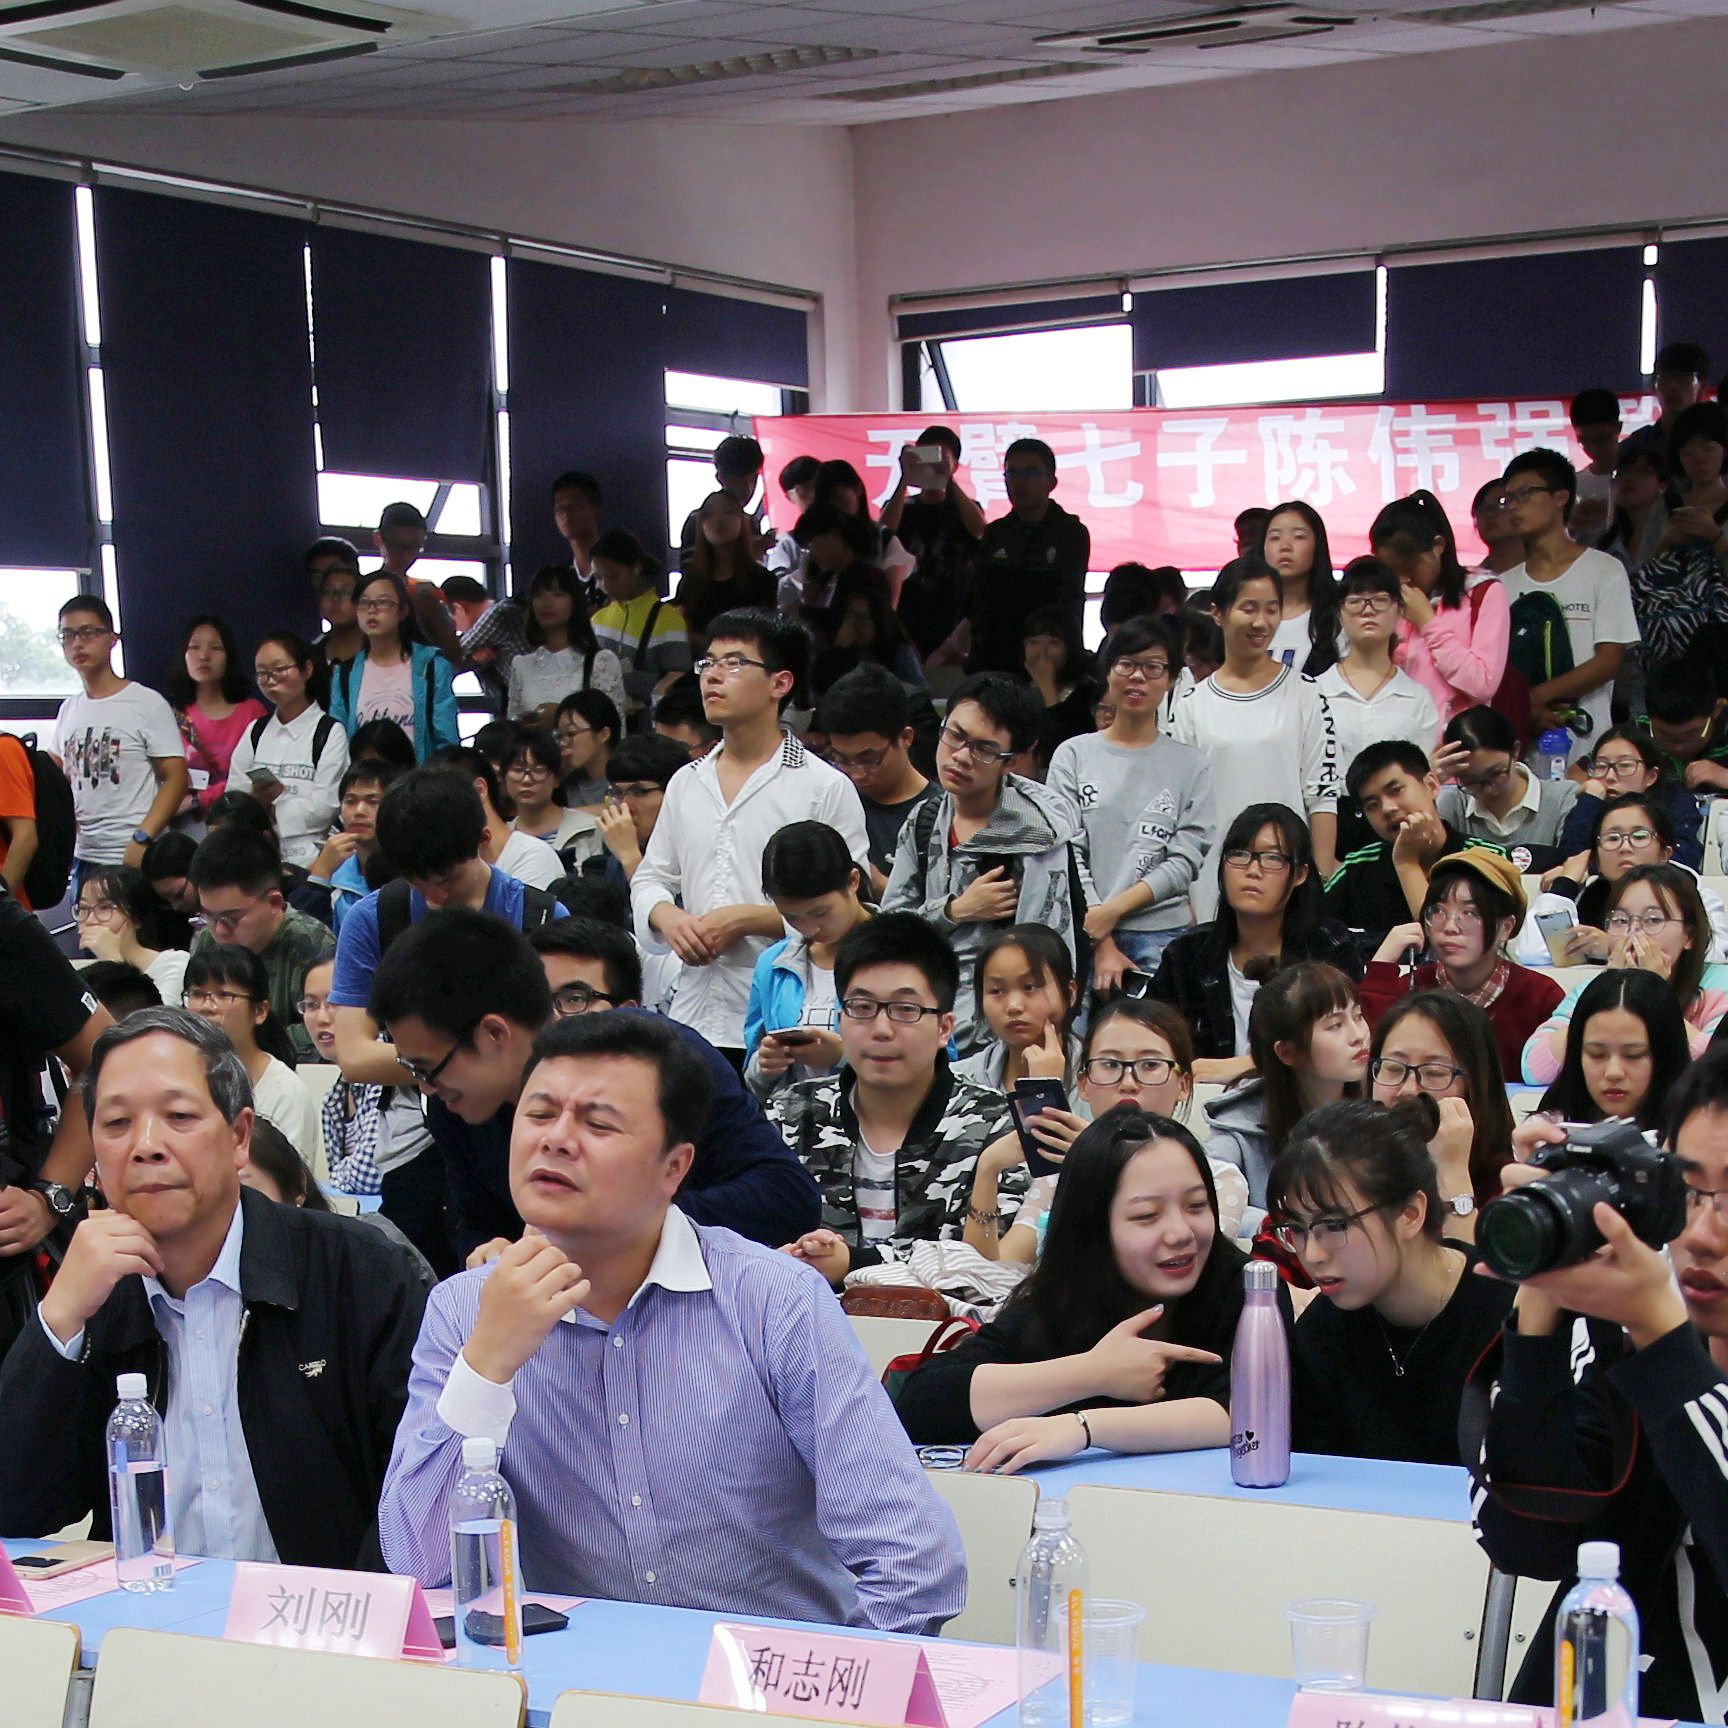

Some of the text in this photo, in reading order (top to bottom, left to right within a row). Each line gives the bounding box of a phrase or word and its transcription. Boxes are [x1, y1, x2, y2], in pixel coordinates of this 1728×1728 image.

[260, 1584, 373, 1641] 刘刚
[750, 1645, 871, 1710] 和志刚
